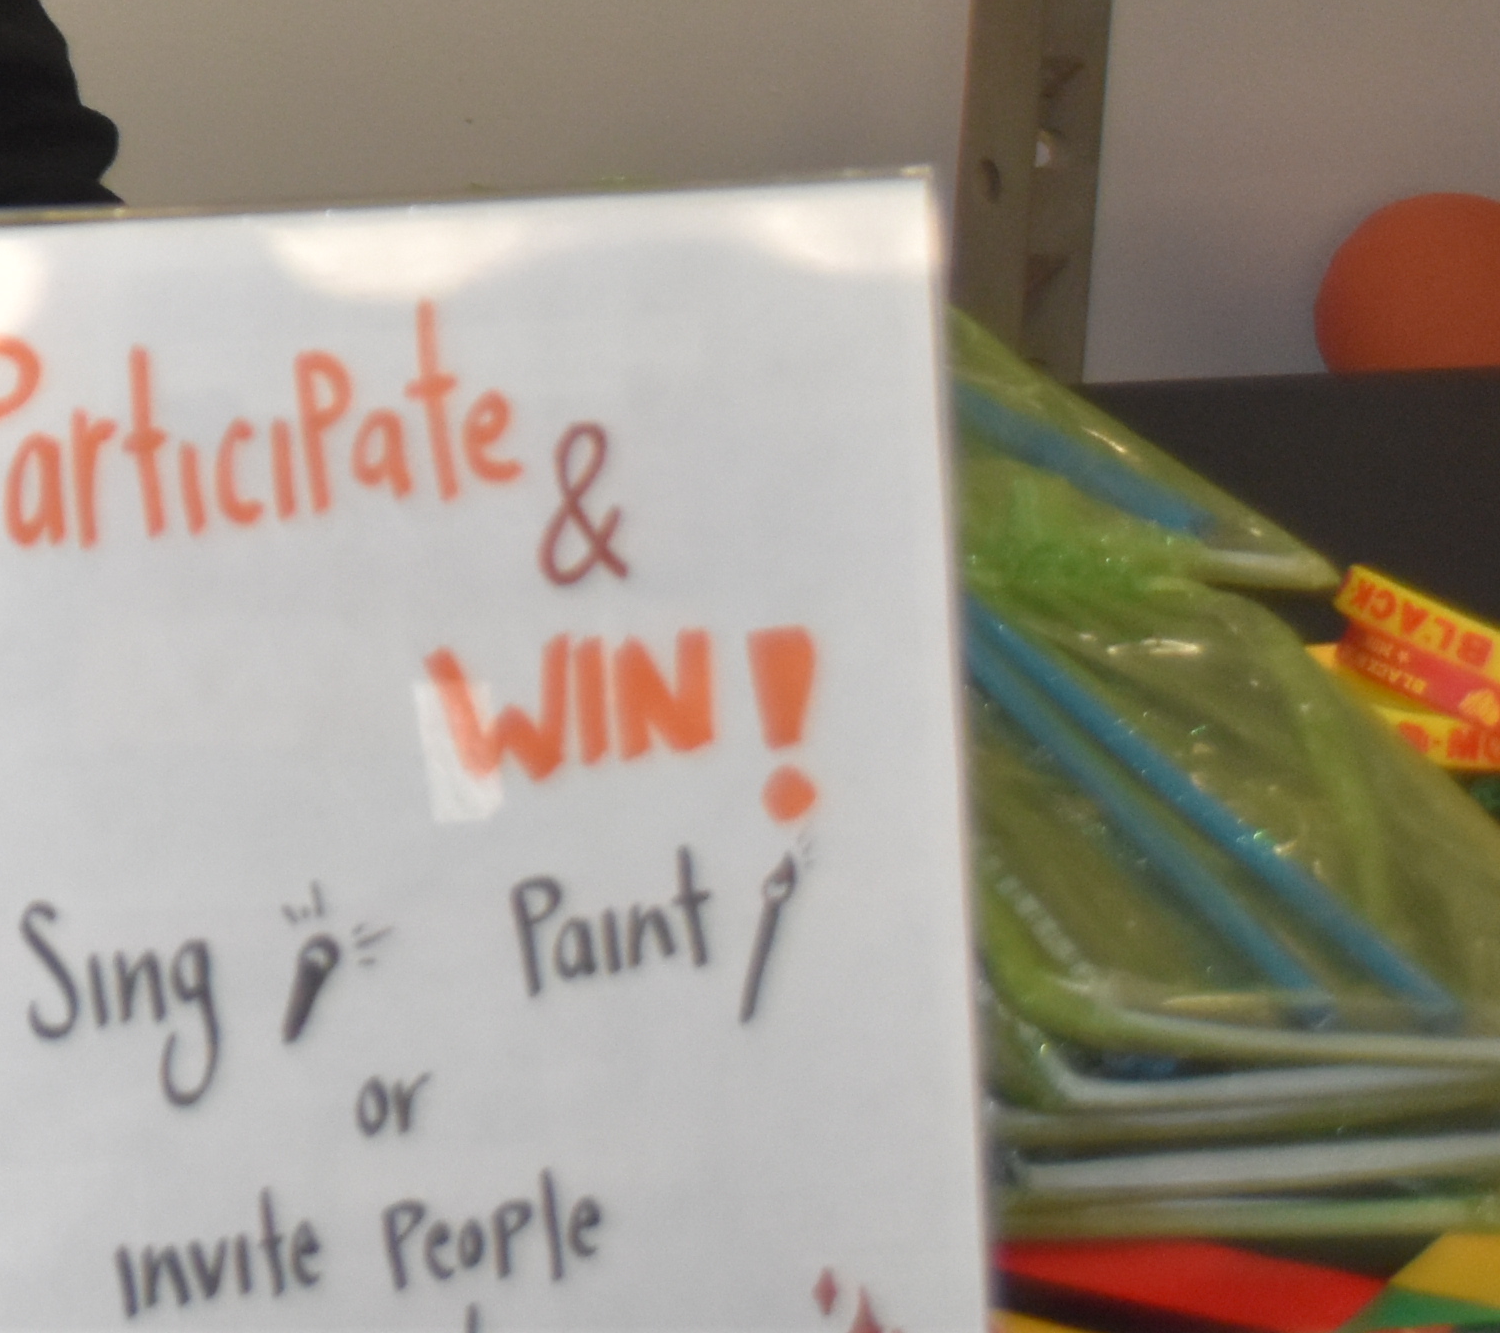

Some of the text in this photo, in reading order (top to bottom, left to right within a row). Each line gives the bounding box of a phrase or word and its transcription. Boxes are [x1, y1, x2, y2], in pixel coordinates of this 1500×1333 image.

[538, 421, 629, 585] &
[1352, 579, 1495, 671] BLACK
[18, 843, 713, 1107] Sing Paint
[356, 1069, 432, 1138] or
[113, 1185, 323, 1319] invite
